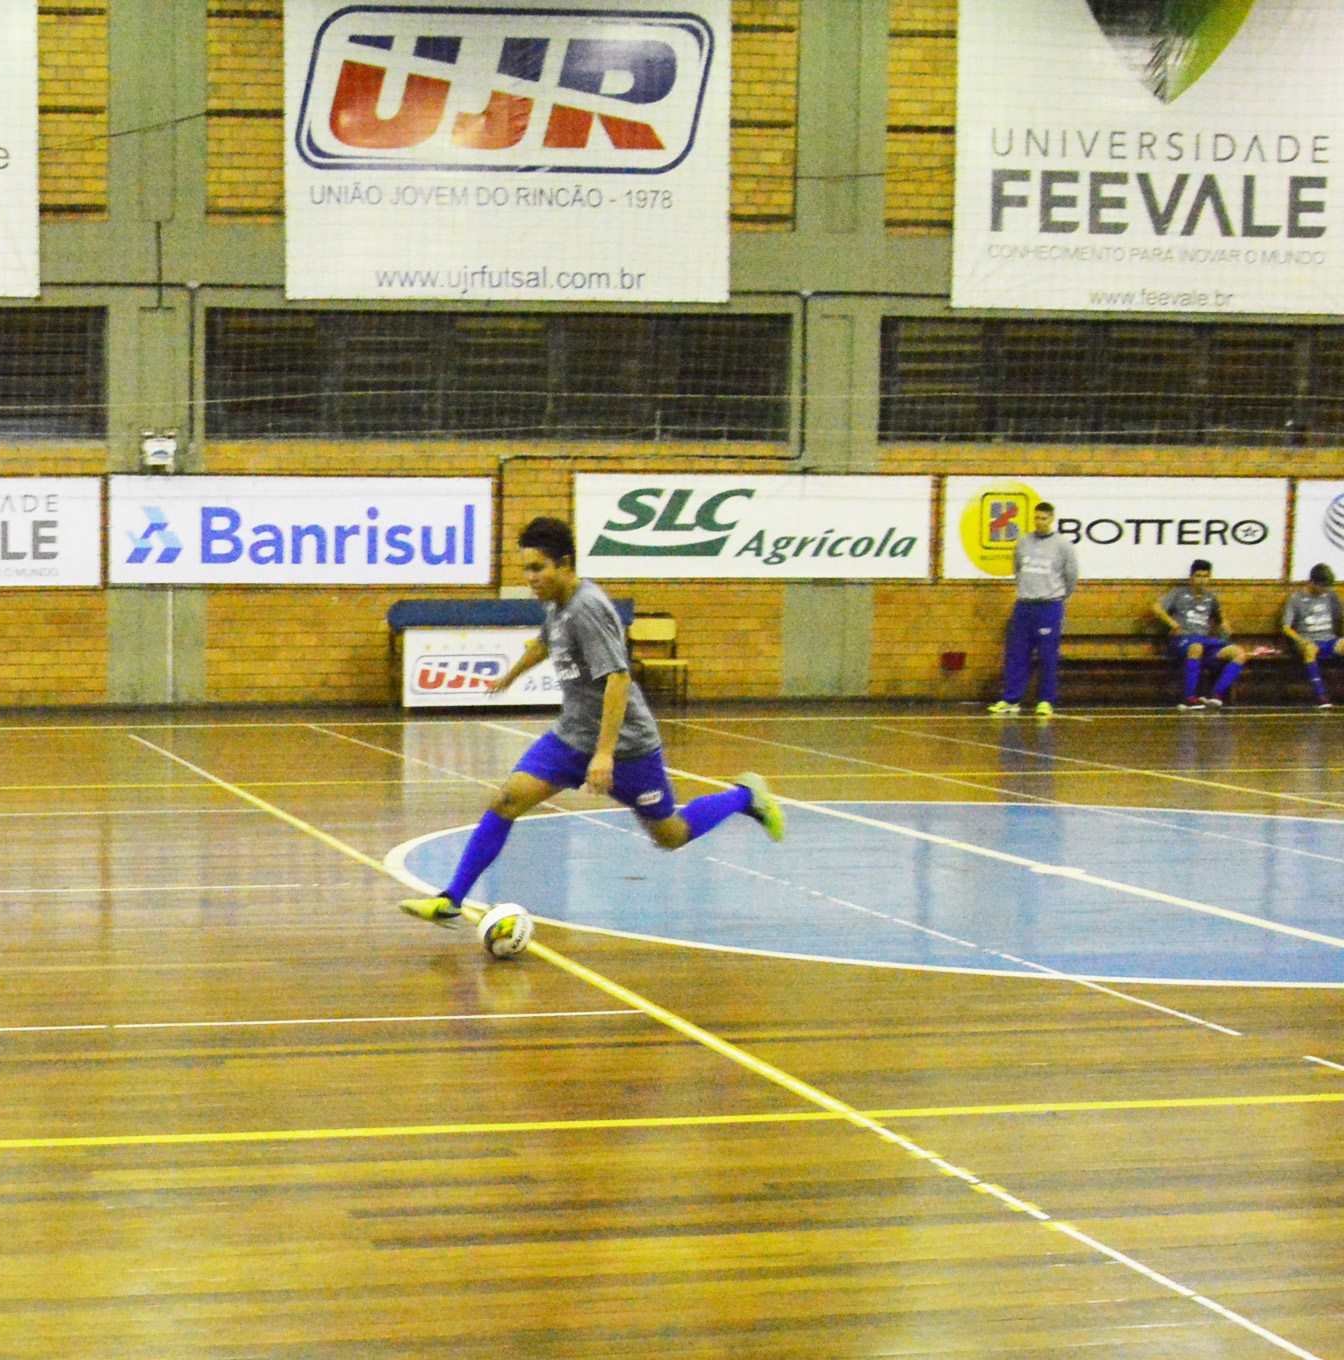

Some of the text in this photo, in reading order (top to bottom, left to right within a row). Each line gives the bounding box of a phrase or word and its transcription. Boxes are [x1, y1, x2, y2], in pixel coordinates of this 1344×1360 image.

[329, 35, 678, 150] UJR
[992, 127, 1331, 164] UNIVERSIDADE
[309, 181, 383, 206] UNIÃO
[389, 186, 467, 206] JOVEM
[476, 187, 509, 206] DO
[516, 184, 603, 208] RINCÃO
[626, 189, 673, 209] 1978
[989, 168, 1328, 238] FEEVALE
[988, 244, 1326, 265] CONHECIMENTO PARA INOVAR O MUNDO
[375, 266, 646, 294] www.ujrfutsal.com.br
[1088, 288, 1234, 307] www.feevale.br
[603, 488, 755, 531] SLC
[200, 505, 475, 565] Banrisul
[735, 527, 918, 565] Agrícola
[1058, 519, 1269, 545] BOTTERO
[418, 661, 500, 689] UJR
